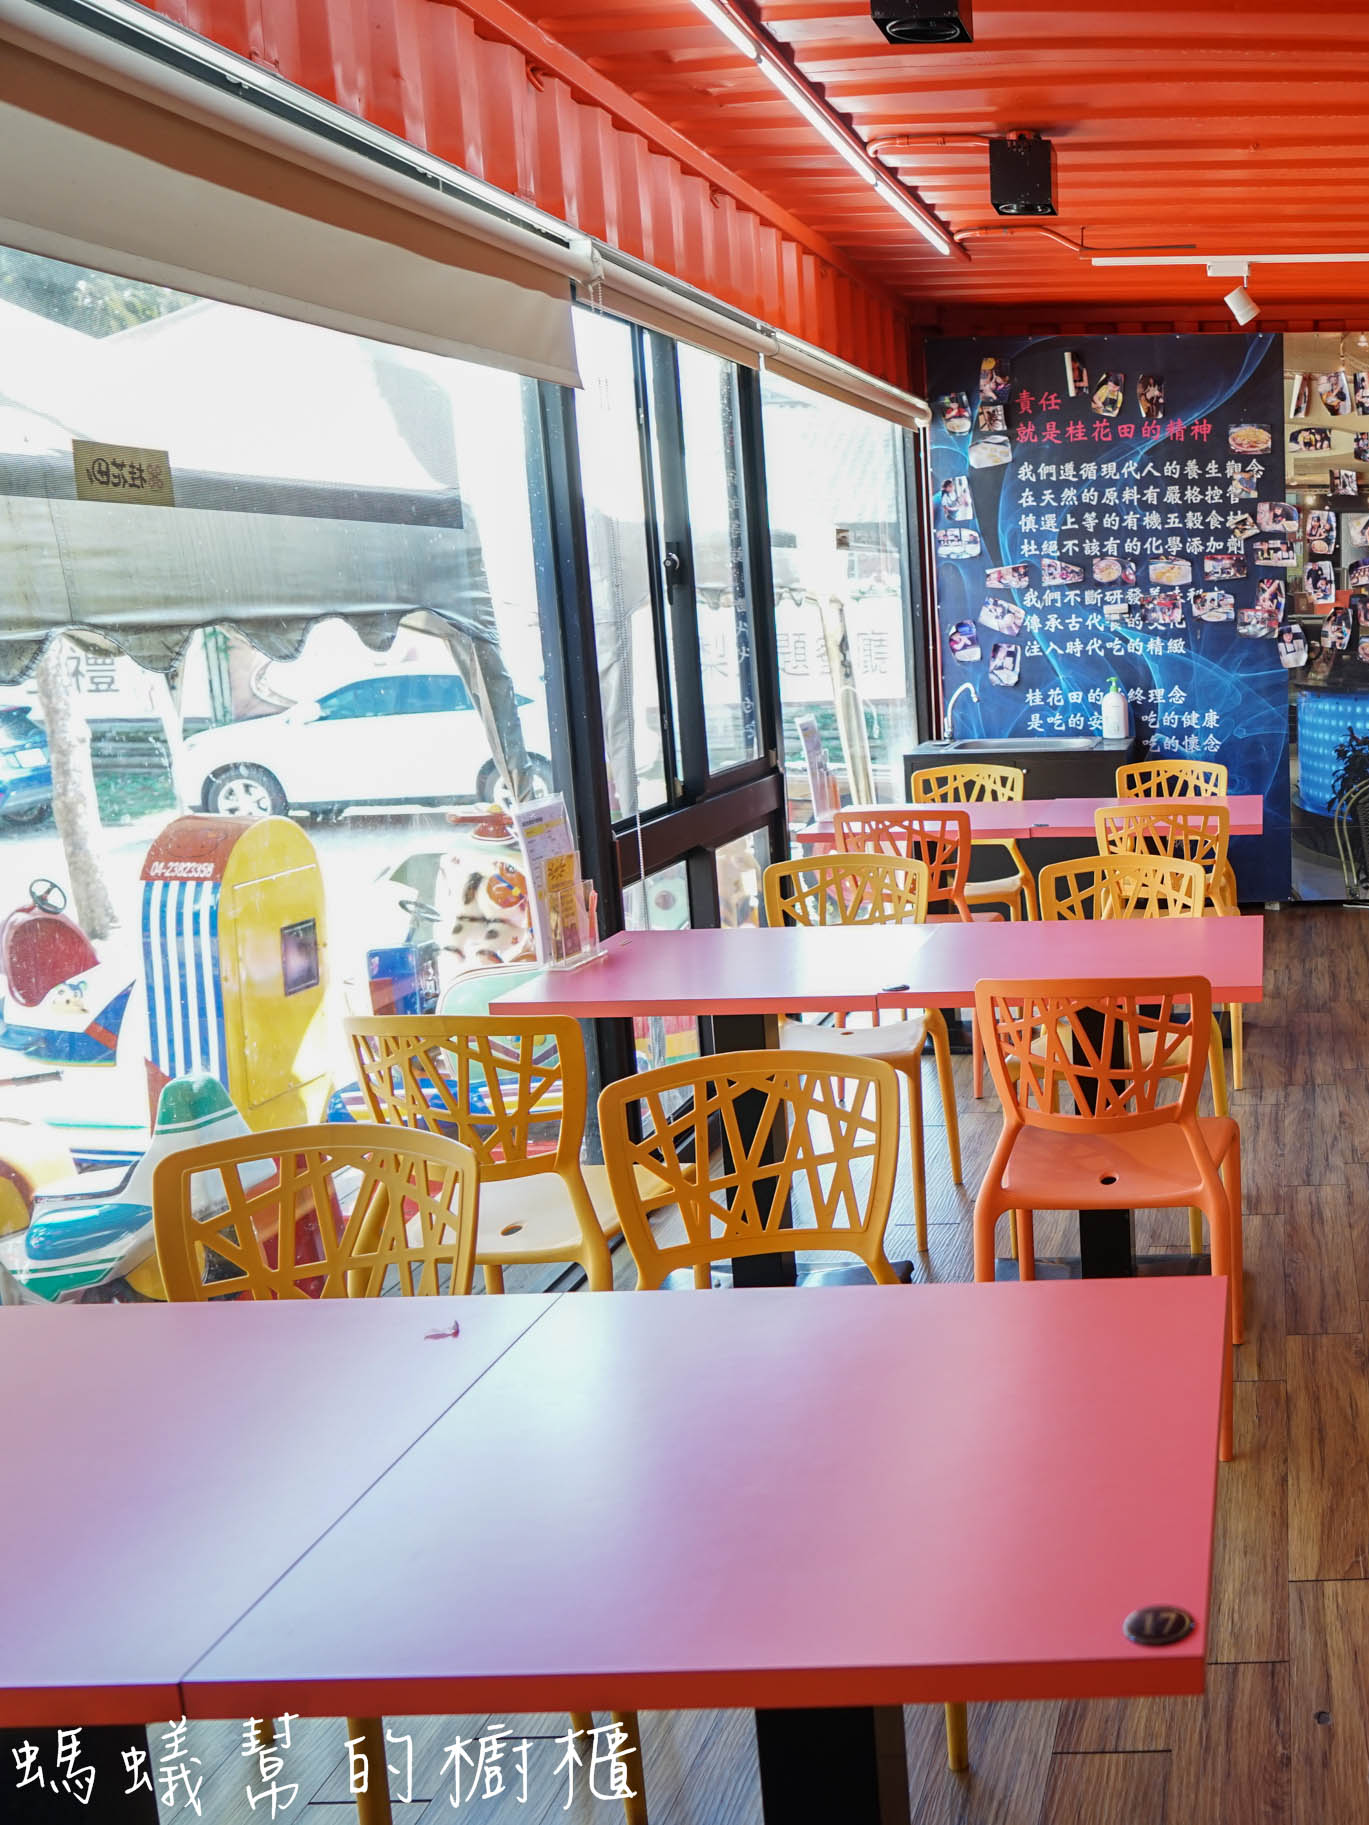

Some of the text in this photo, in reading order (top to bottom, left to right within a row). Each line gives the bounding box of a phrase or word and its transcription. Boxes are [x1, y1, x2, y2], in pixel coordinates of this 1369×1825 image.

[1015, 390, 1063, 414] 責任
[1015, 418, 1213, 443] 就是桂花田的精神
[1017, 459, 1266, 482] 我們遵循現代人的養生觀念
[1020, 535, 1245, 557] 杜絕不該有的化學添加劑
[1024, 636, 1187, 657] 注入時代吃的精緻
[1025, 684, 1188, 706] 桂花田的終理念
[1143, 1611, 1178, 1636] 17
